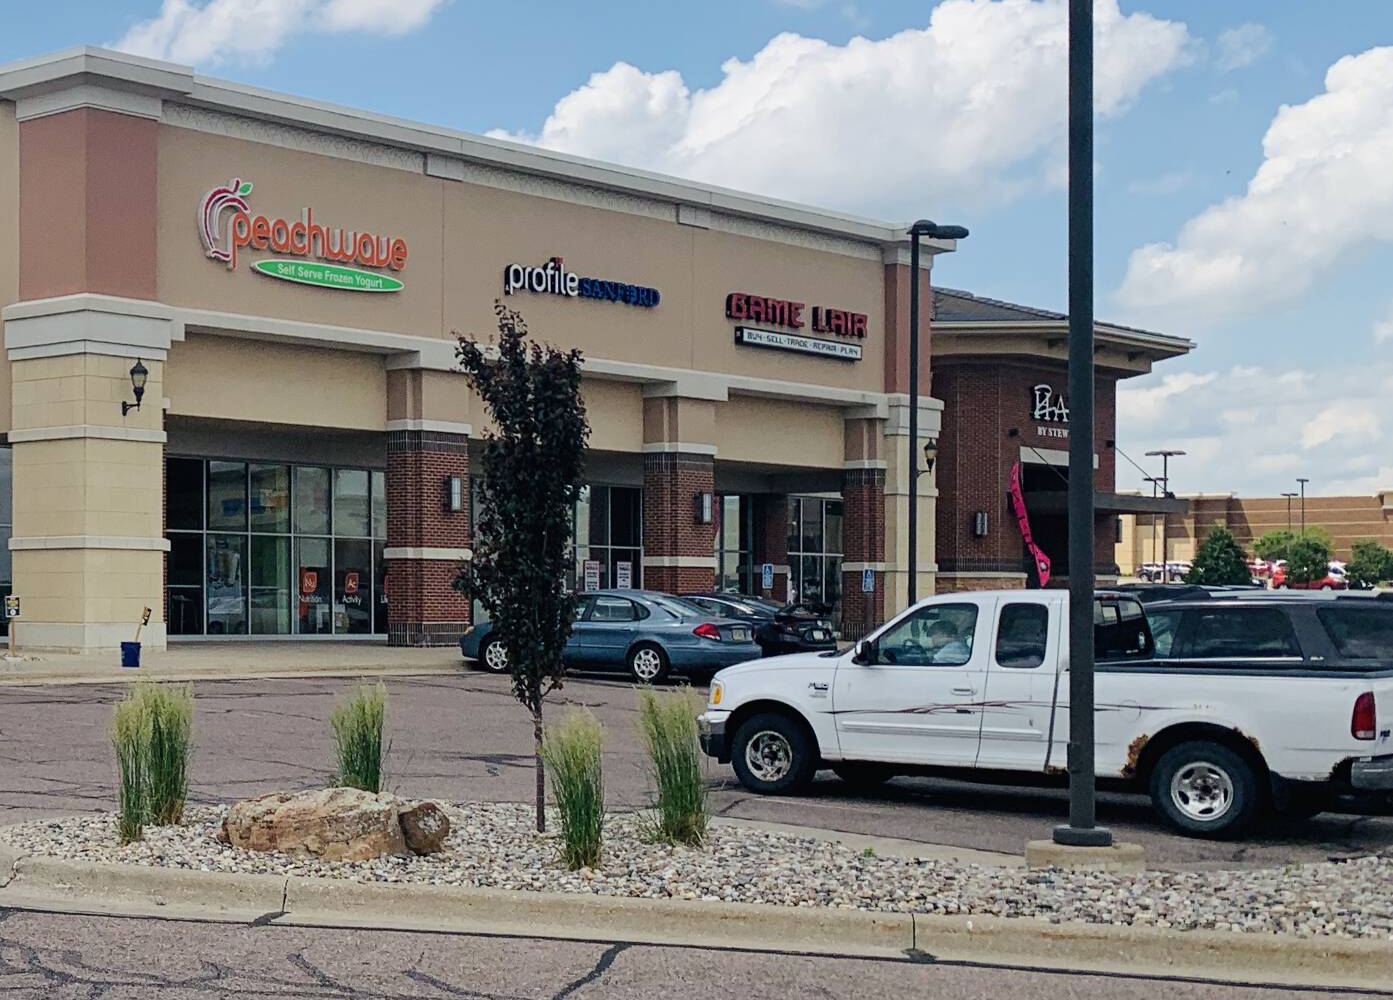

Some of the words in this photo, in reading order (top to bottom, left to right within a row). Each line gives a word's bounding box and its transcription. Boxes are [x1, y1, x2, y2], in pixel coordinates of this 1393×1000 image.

[228, 207, 409, 270] peachwave
[277, 263, 296, 276] Self
[298, 266, 324, 280] Serve
[324, 270, 354, 285] Frozen
[355, 273, 384, 289] Yogurt
[508, 258, 579, 297] profile
[727, 292, 805, 329] GAME
[813, 306, 868, 338] LAIR
[747, 331, 762, 341] BUY
[766, 333, 784, 345] SELL
[787, 337, 808, 348] TRADE
[840, 345, 859, 357] PLAY
[1037, 426, 1047, 436] BY
[1048, 427, 1069, 438] STEW
